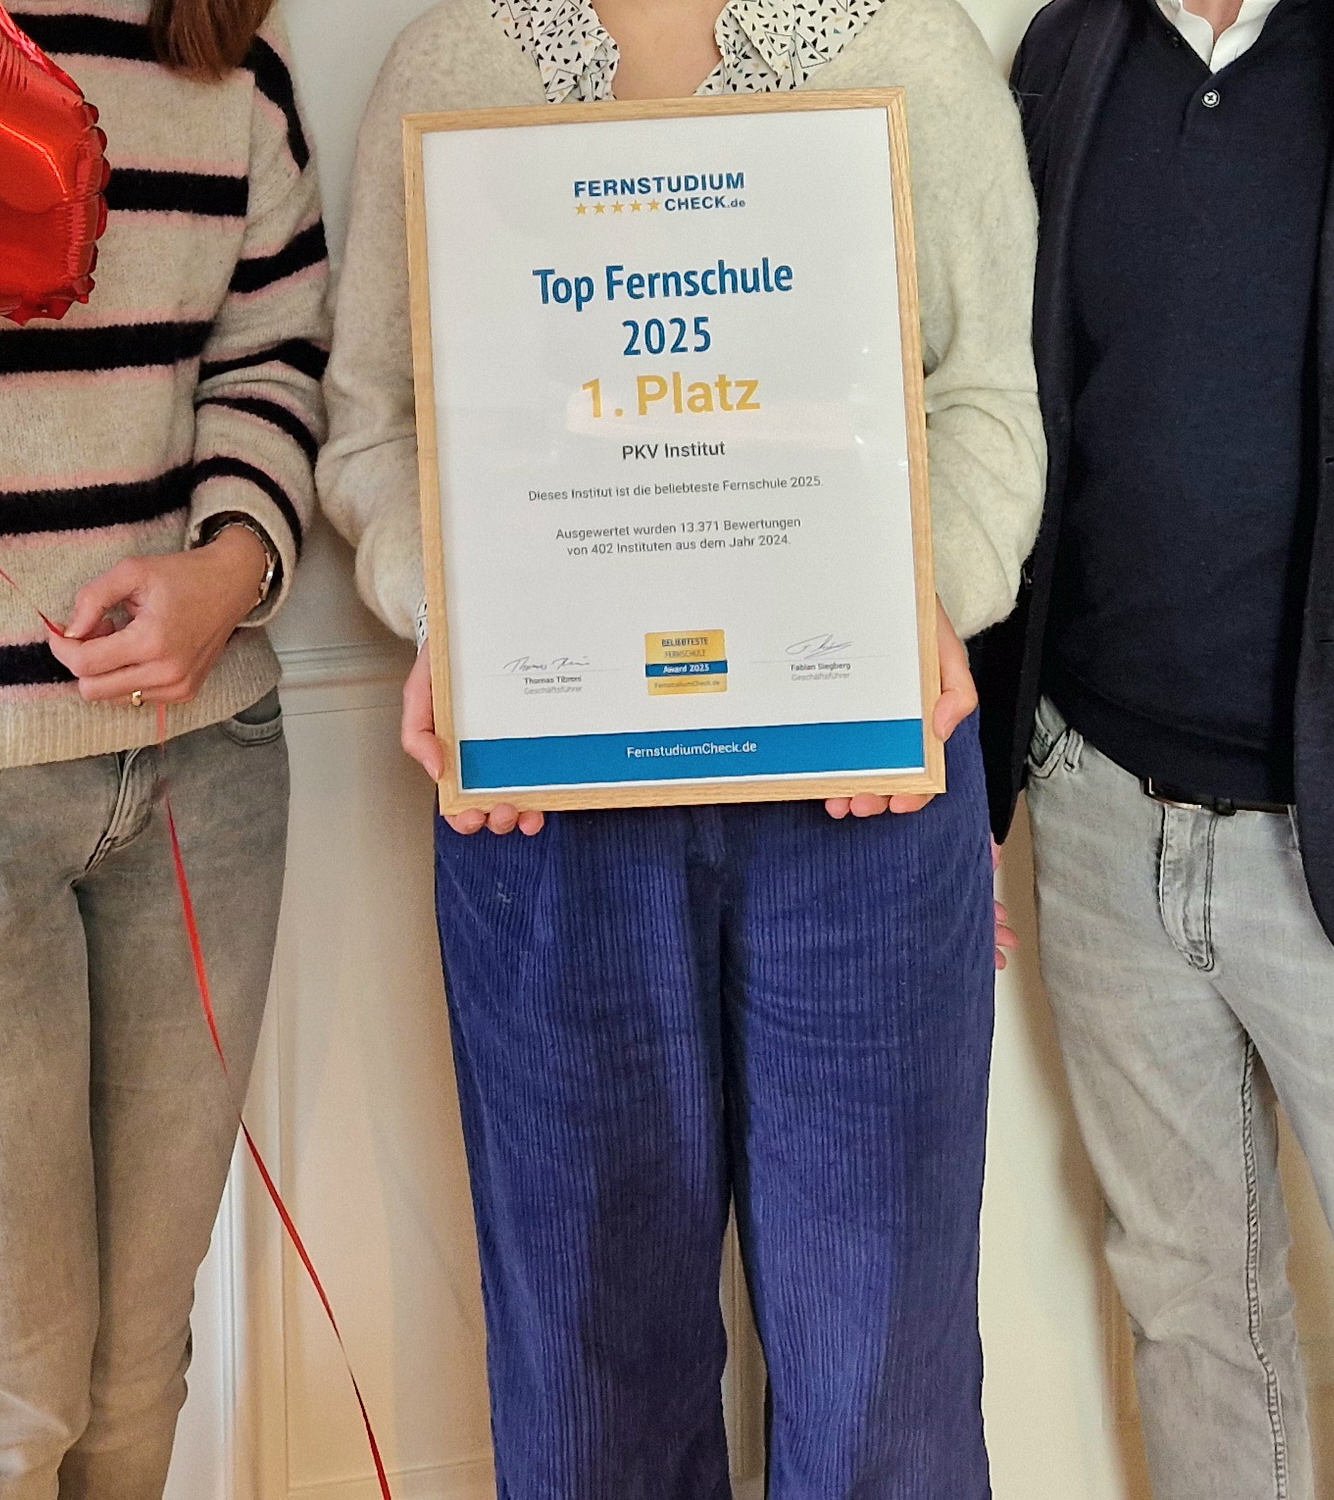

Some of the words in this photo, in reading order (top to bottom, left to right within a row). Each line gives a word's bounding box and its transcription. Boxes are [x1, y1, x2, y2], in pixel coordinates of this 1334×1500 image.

[574, 172, 745, 197] FERNSTUDIUM
[664, 195, 746, 211] CHECK.de
[532, 268, 595, 312] Top
[606, 257, 793, 300] Fernschule
[622, 316, 712, 356] 2025
[582, 377, 624, 418] 1.
[636, 371, 761, 416] Platz
[622, 444, 659, 460] PKV
[664, 441, 726, 458] Institut
[528, 488, 568, 501] Dieses
[571, 486, 613, 499] Institut
[615, 485, 630, 497] ist
[633, 483, 651, 496] die
[654, 480, 720, 495] beliebteste
[722, 477, 788, 492] Fernschule
[790, 475, 823, 488] 2025.
[555, 525, 630, 541] Ausgewertet
[633, 523, 677, 536] wurden
[680, 520, 719, 534] 13.371
[723, 516, 801, 532] Bewertungen
[567, 545, 588, 556] von
[591, 542, 614, 555] 402
[617, 539, 672, 554] Instituten
[675, 540, 696, 551] aus
[699, 536, 727, 549] dem
[729, 535, 755, 548] Jahr
[758, 533, 791, 546] 2024.
[663, 665, 687, 674] Award
[626, 740, 757, 759] FernstudiumCheck.de
